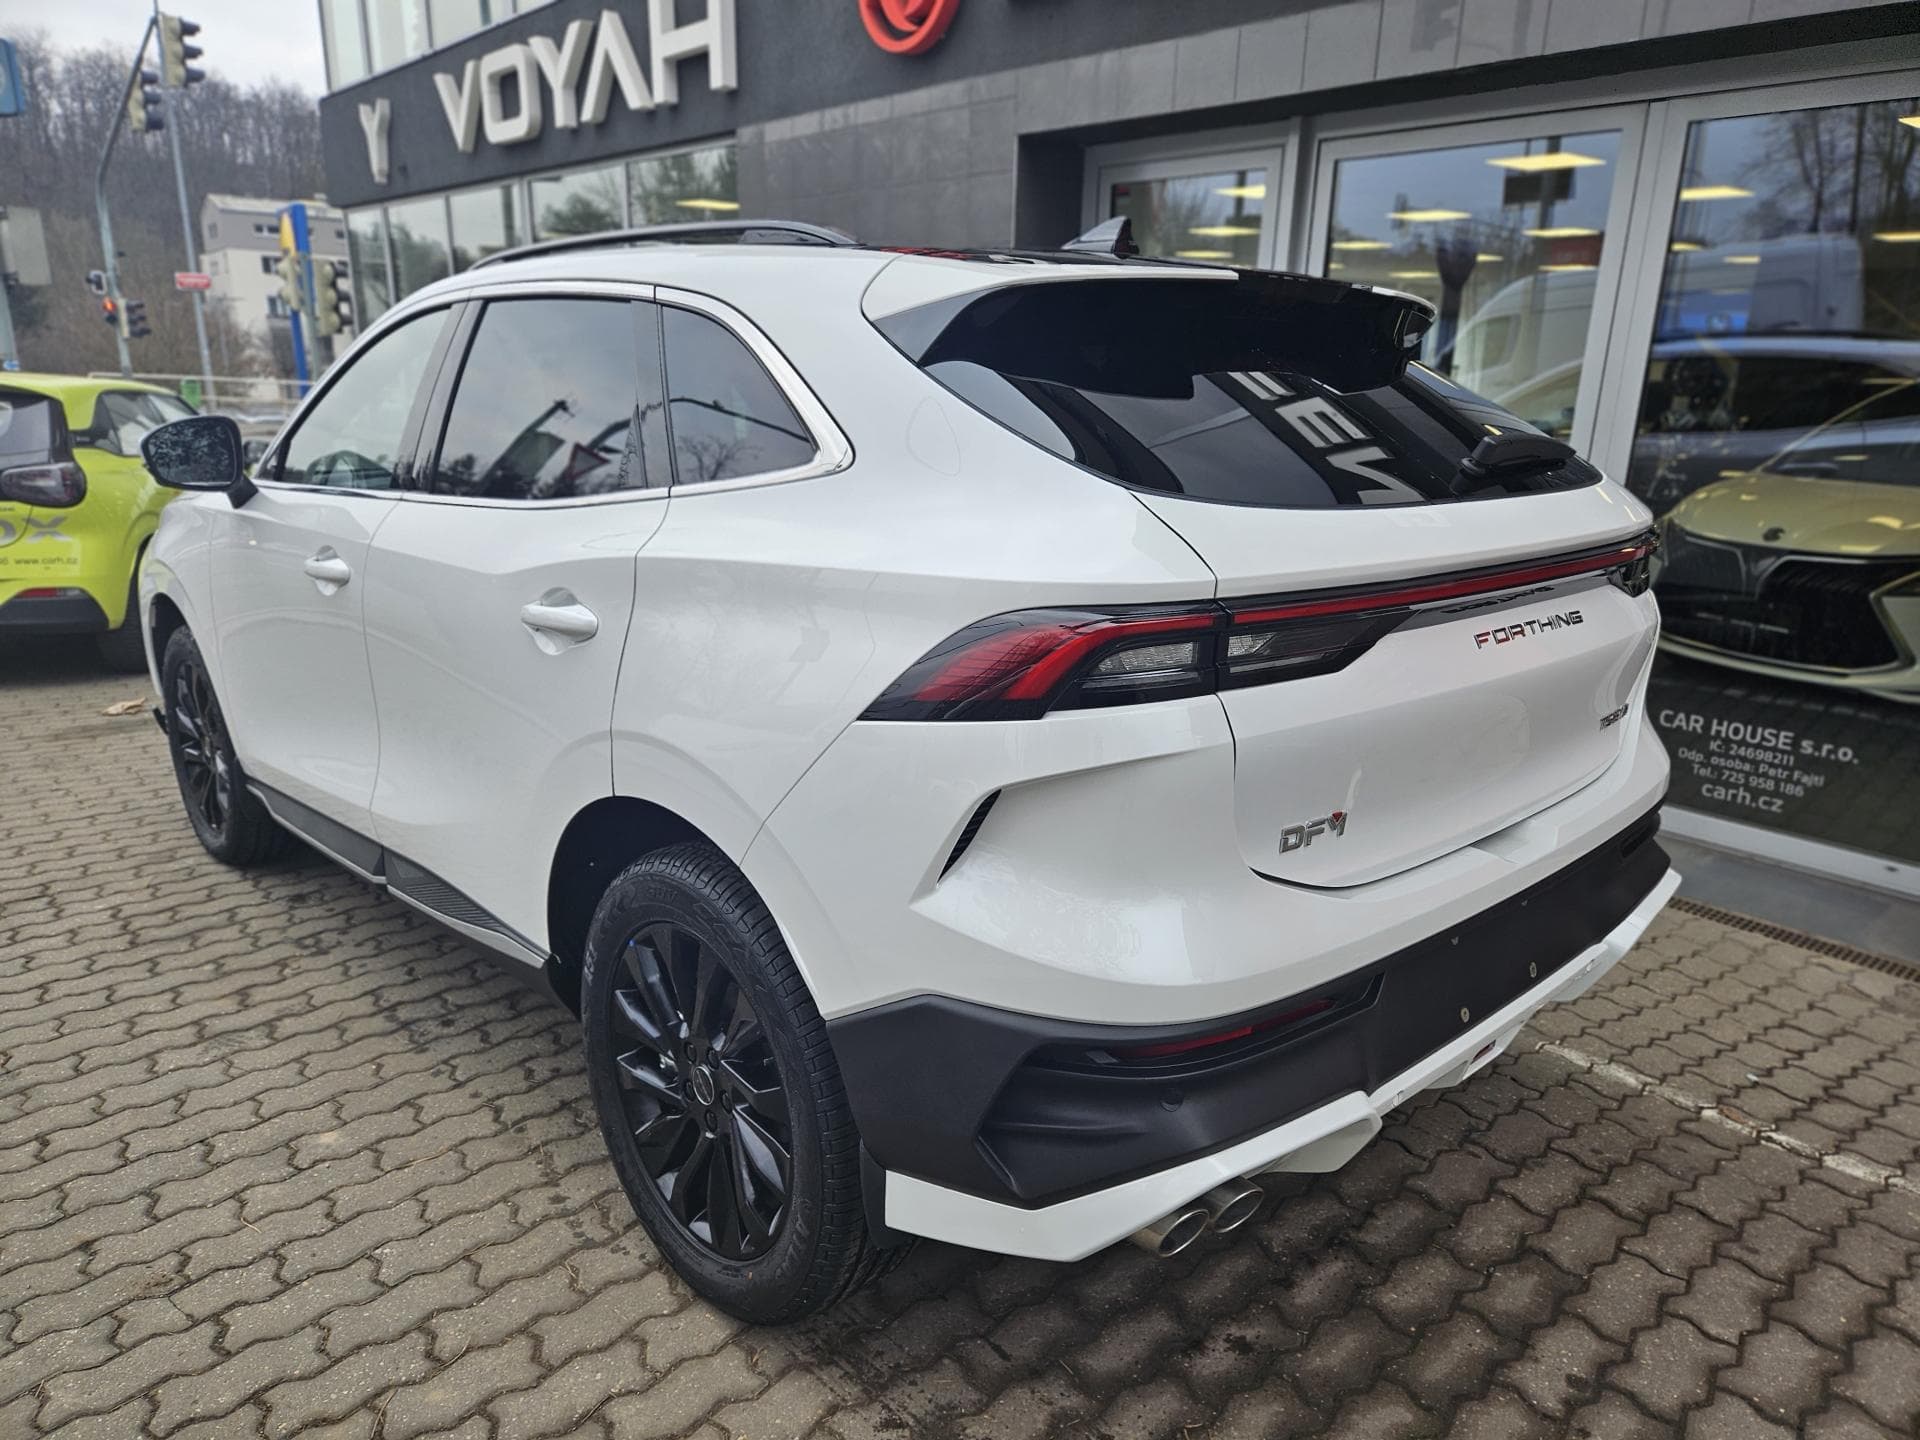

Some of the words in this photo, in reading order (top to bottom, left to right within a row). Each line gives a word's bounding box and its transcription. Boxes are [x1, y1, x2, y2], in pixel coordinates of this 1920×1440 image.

[434, 0, 738, 154] VOYAH
[1473, 610, 1584, 650] FORTHING
[1659, 709, 1704, 734] CAR
[1710, 718, 1795, 750] HOUSE
[1799, 739, 1859, 765] s.r.o.
[1710, 756, 1755, 773] osoba:
[1758, 763, 1790, 780] Petr
[1728, 743, 1795, 767] 24698211
[1721, 769, 1746, 785] 725
[1748, 775, 1776, 791] 958
[1701, 783, 1785, 814] carh.cz
